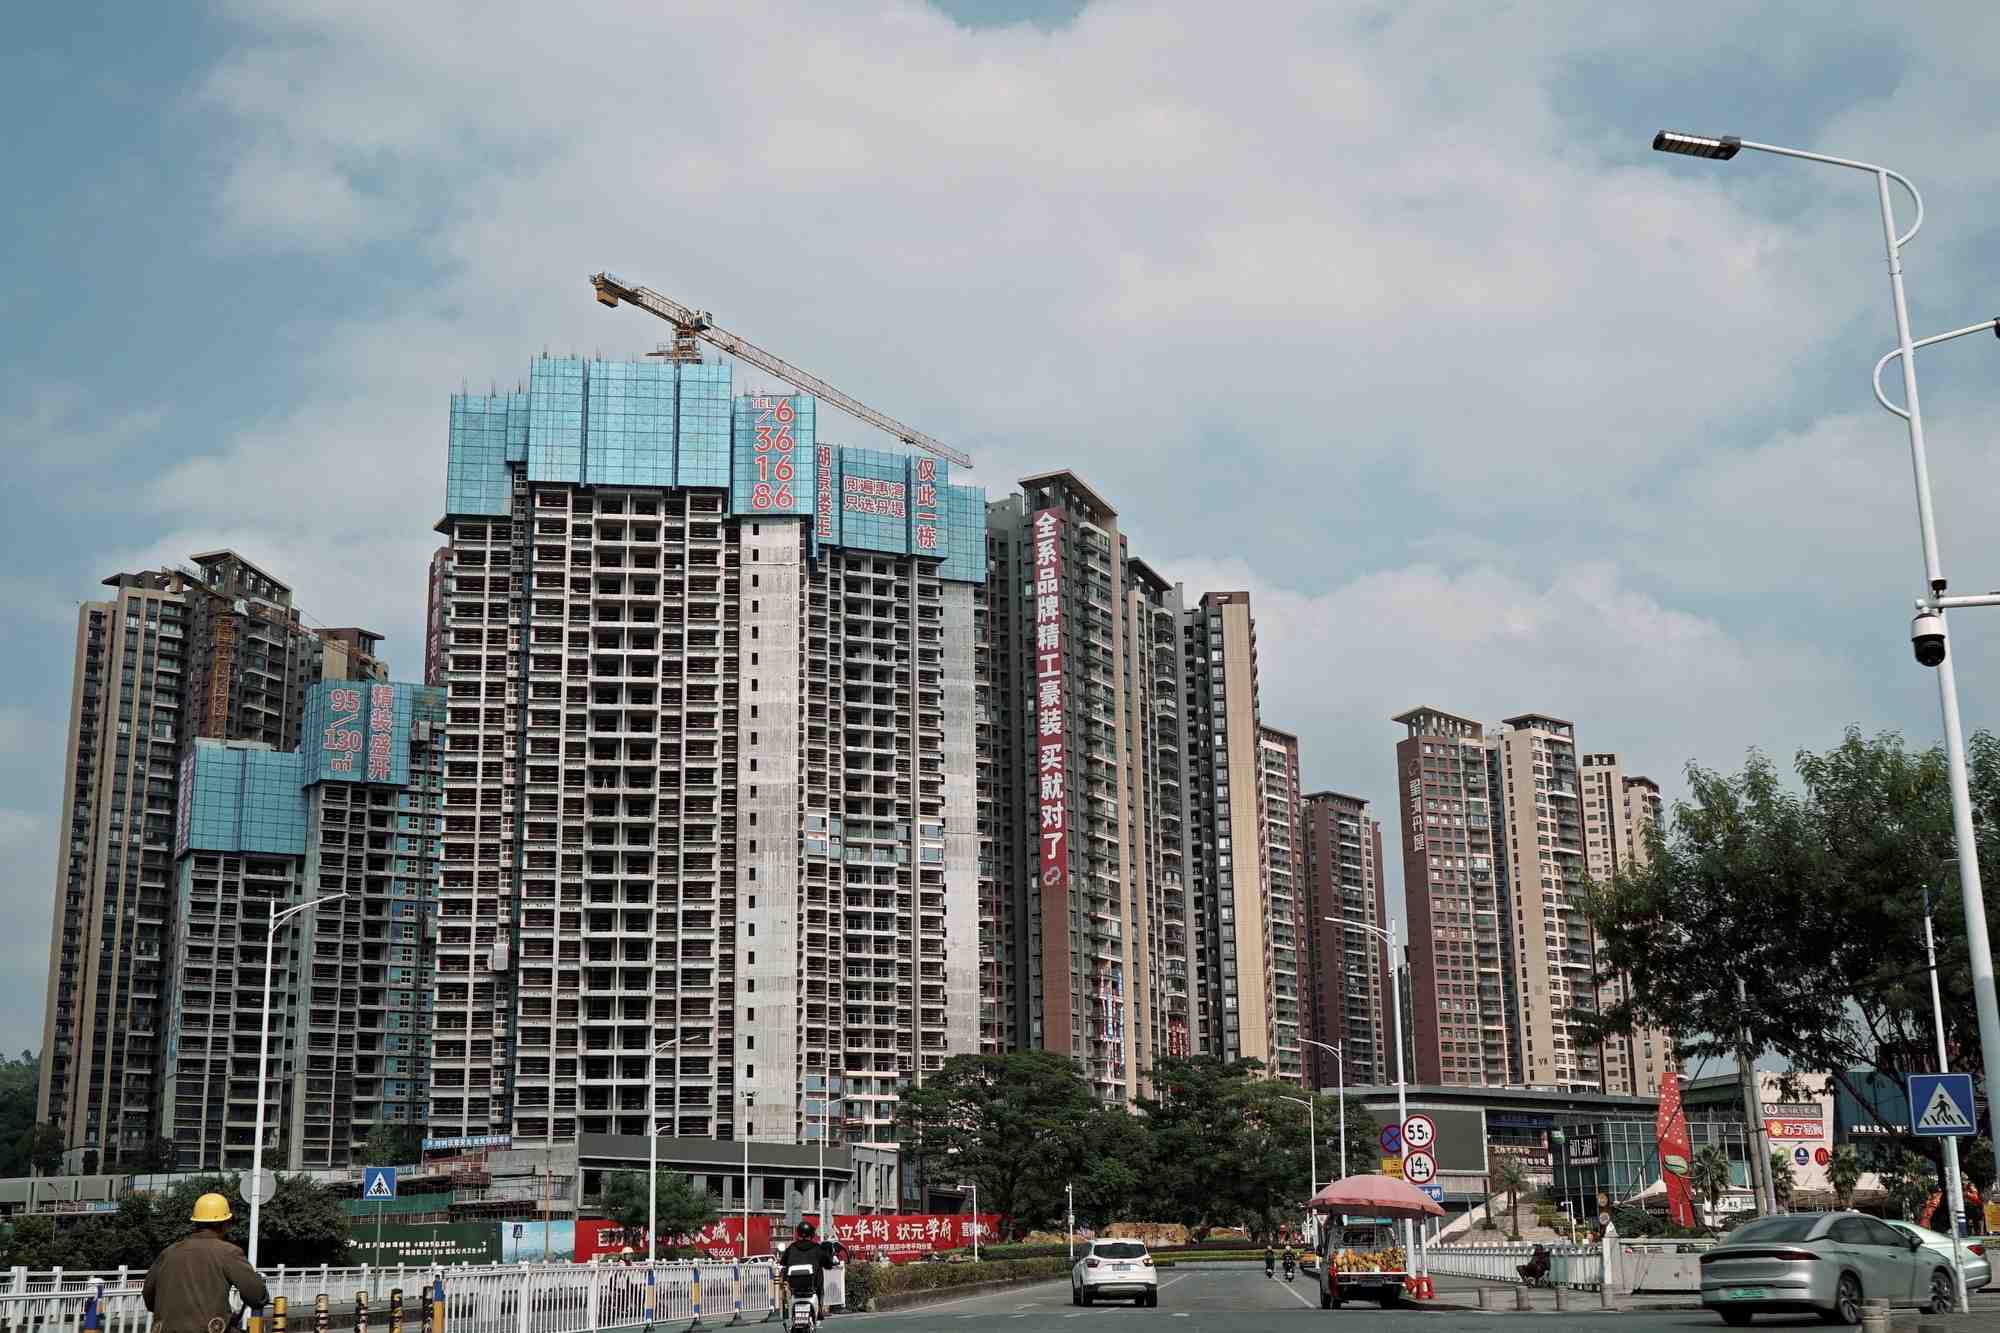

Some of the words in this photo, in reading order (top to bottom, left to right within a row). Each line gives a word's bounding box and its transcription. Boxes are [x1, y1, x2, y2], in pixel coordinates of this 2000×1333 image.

[753, 426, 794, 453] 36
[755, 454, 794, 481] 16
[752, 482, 794, 511] 86
[917, 459, 937, 549] 仅此一栋
[1036, 512, 1061, 736] 全系品牌精工豪装
[330, 688, 361, 712] 95
[325, 729, 362, 753] 130
[1040, 744, 1066, 860] 买就对了
[1408, 1124, 1429, 1140] 55t
[896, 1218, 952, 1241] 状元学府
